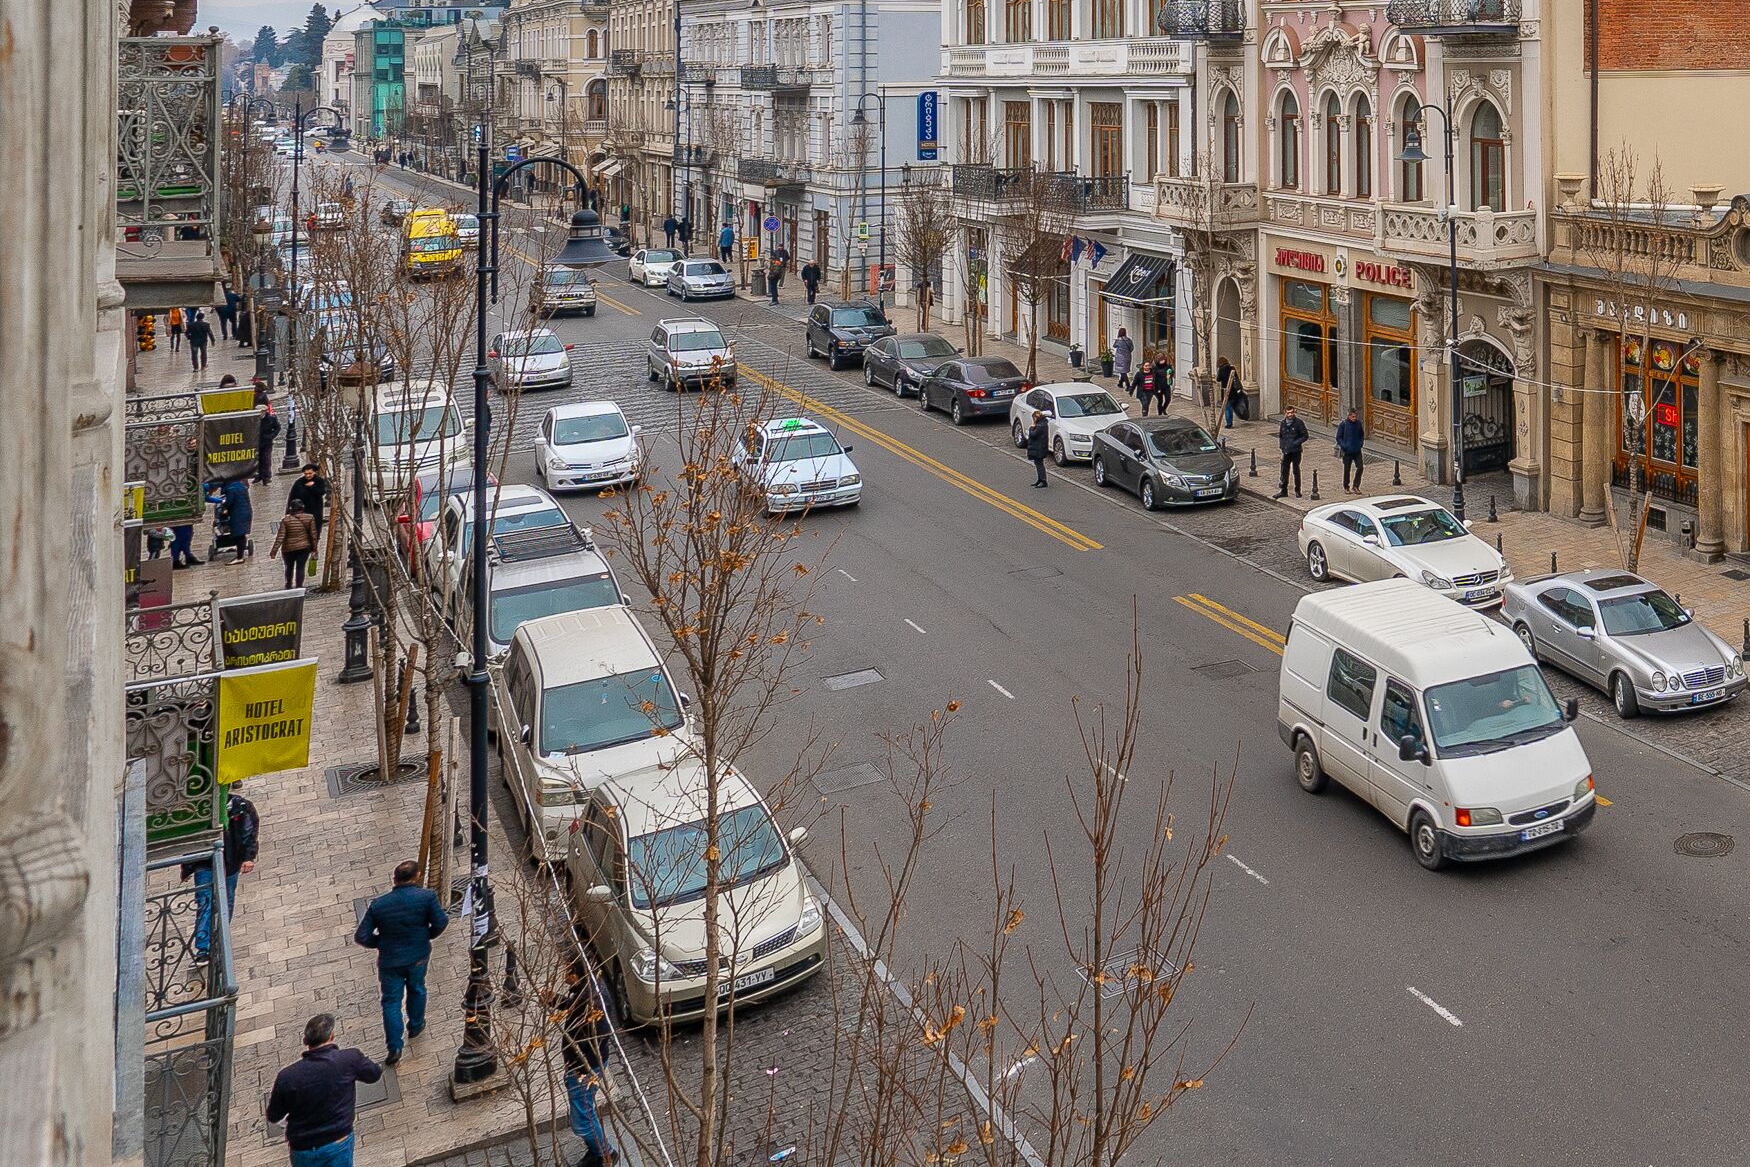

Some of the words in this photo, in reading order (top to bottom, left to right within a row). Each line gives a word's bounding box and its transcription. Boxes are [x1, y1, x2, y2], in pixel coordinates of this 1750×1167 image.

[1355, 260, 1413, 289] POLICE
[220, 433, 244, 445] HOTEL
[208, 448, 256, 464] ARISTOCRAT
[224, 620, 297, 644] სასტუმრო
[245, 698, 285, 719] HOTEL
[224, 718, 304, 750] ARISTOCRAT
